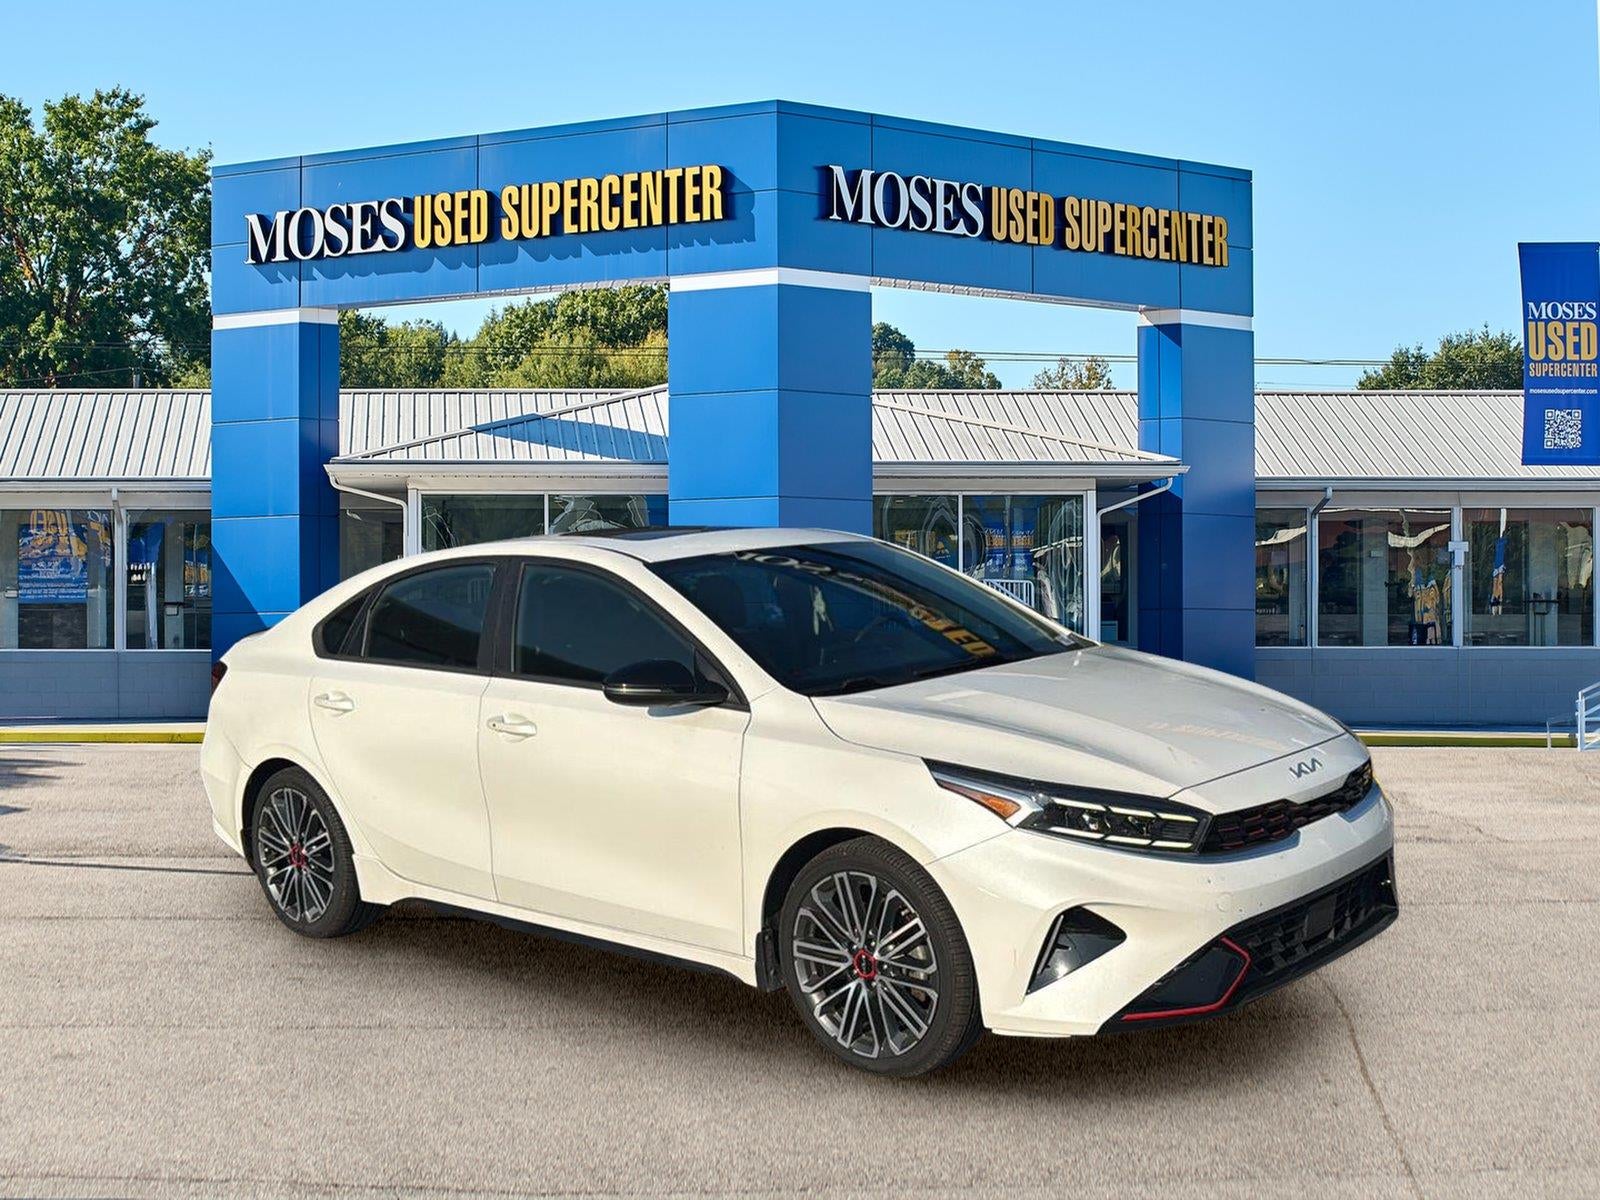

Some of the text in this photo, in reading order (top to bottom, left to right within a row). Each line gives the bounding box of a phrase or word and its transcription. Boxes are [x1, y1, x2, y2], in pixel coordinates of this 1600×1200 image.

[244, 164, 724, 265] MOSES USED SUPERCENTER
[828, 164, 1229, 267] MOSES USED SUPERCENTER
[1527, 301, 1597, 320] MOSES
[1528, 321, 1598, 361] USED
[1529, 362, 1598, 377] SUPERCENTER
[1289, 757, 1323, 778] KIA
